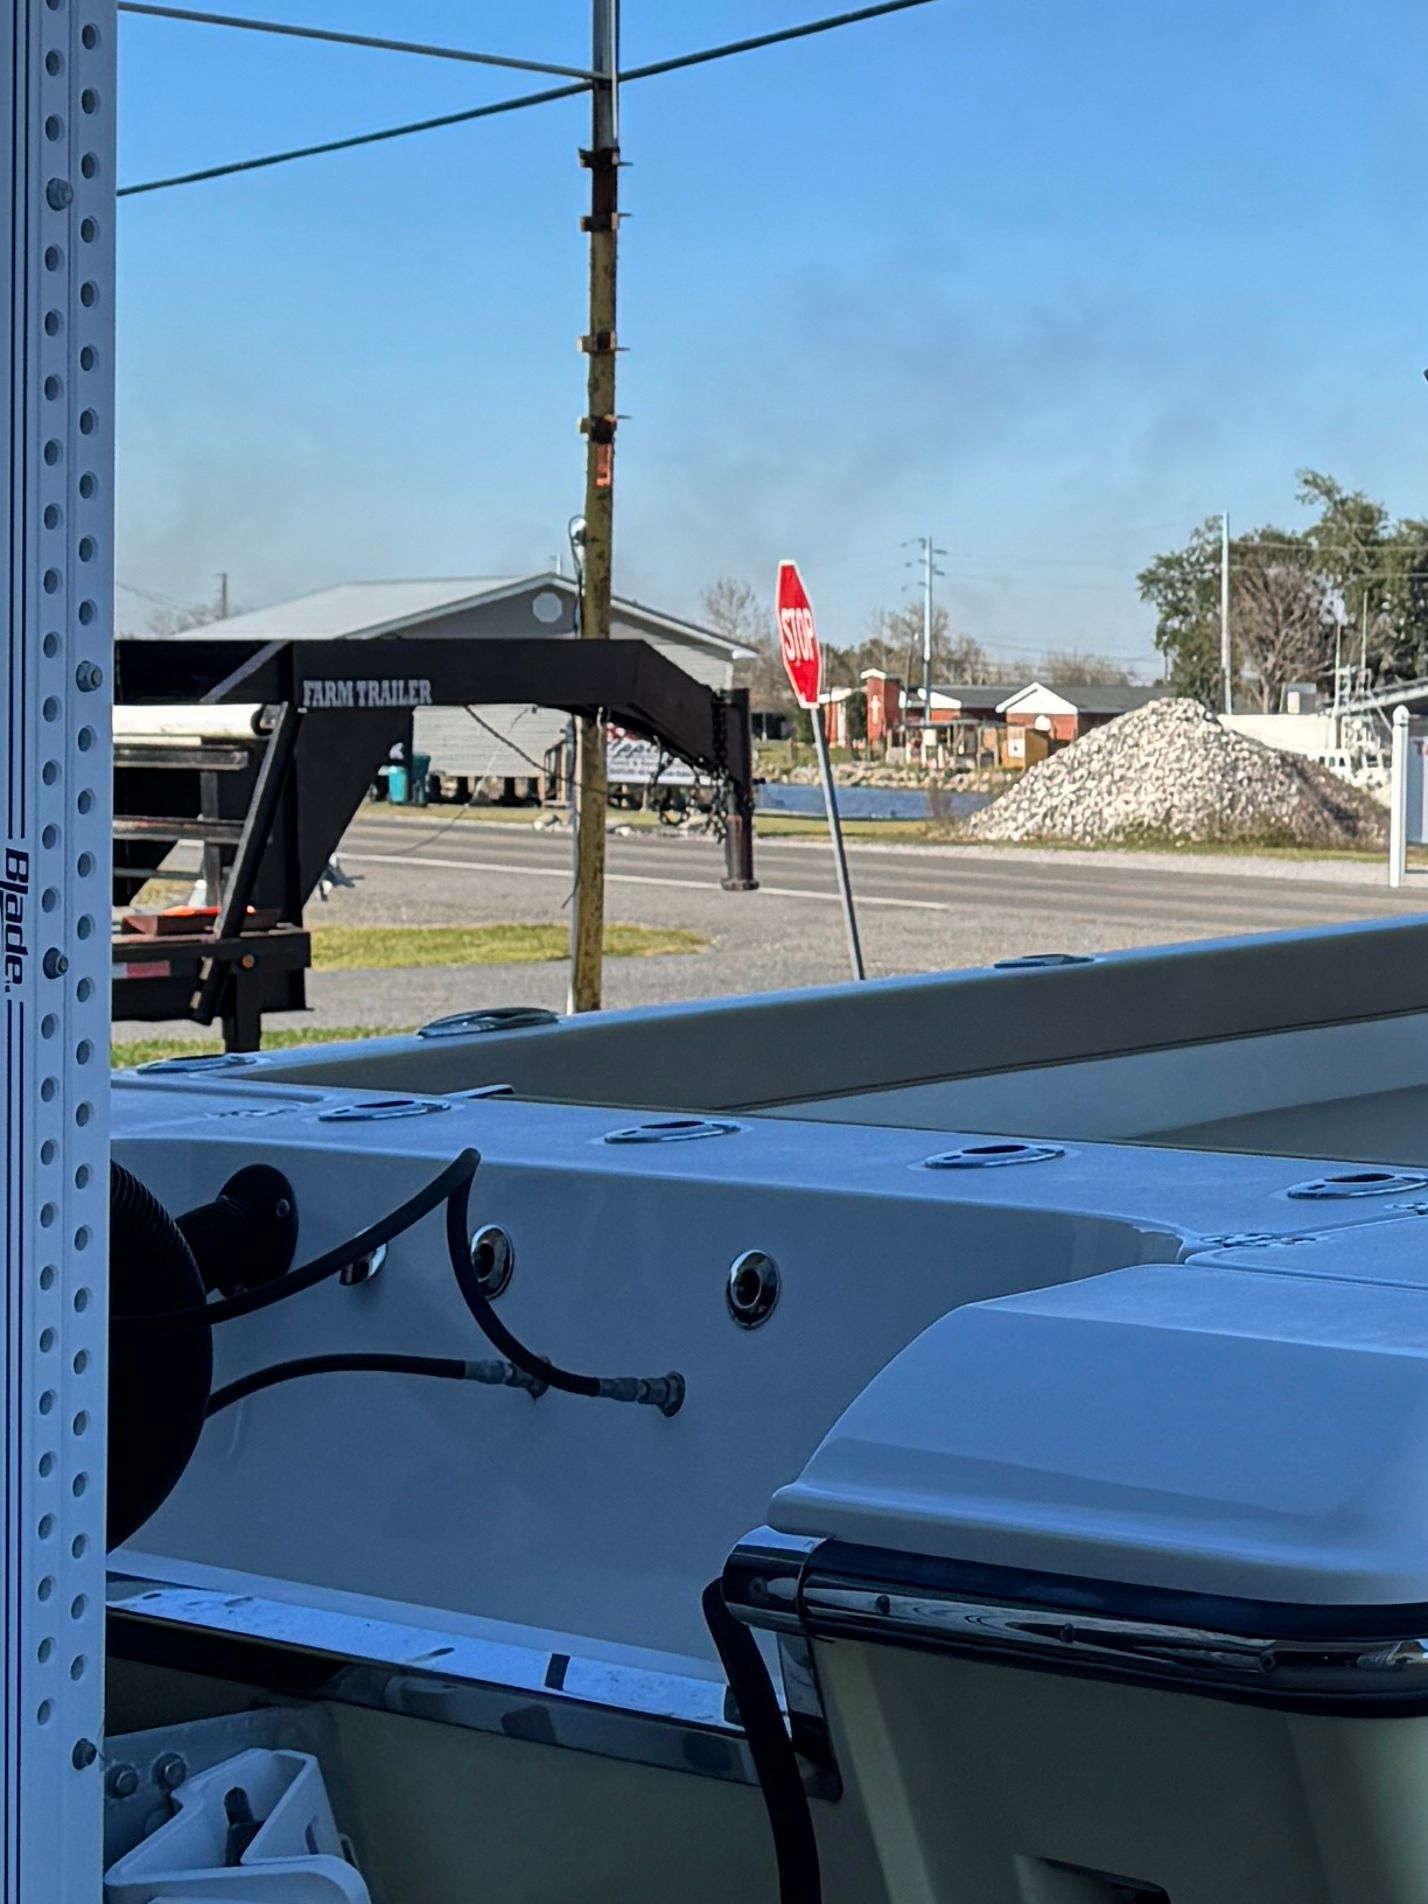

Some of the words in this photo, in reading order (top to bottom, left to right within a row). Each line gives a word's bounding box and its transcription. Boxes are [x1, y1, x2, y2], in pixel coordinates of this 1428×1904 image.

[781, 607, 815, 662] STOP
[303, 680, 354, 707] FARM
[356, 679, 432, 707] TRAILER
[0, 848, 30, 985] Blade
